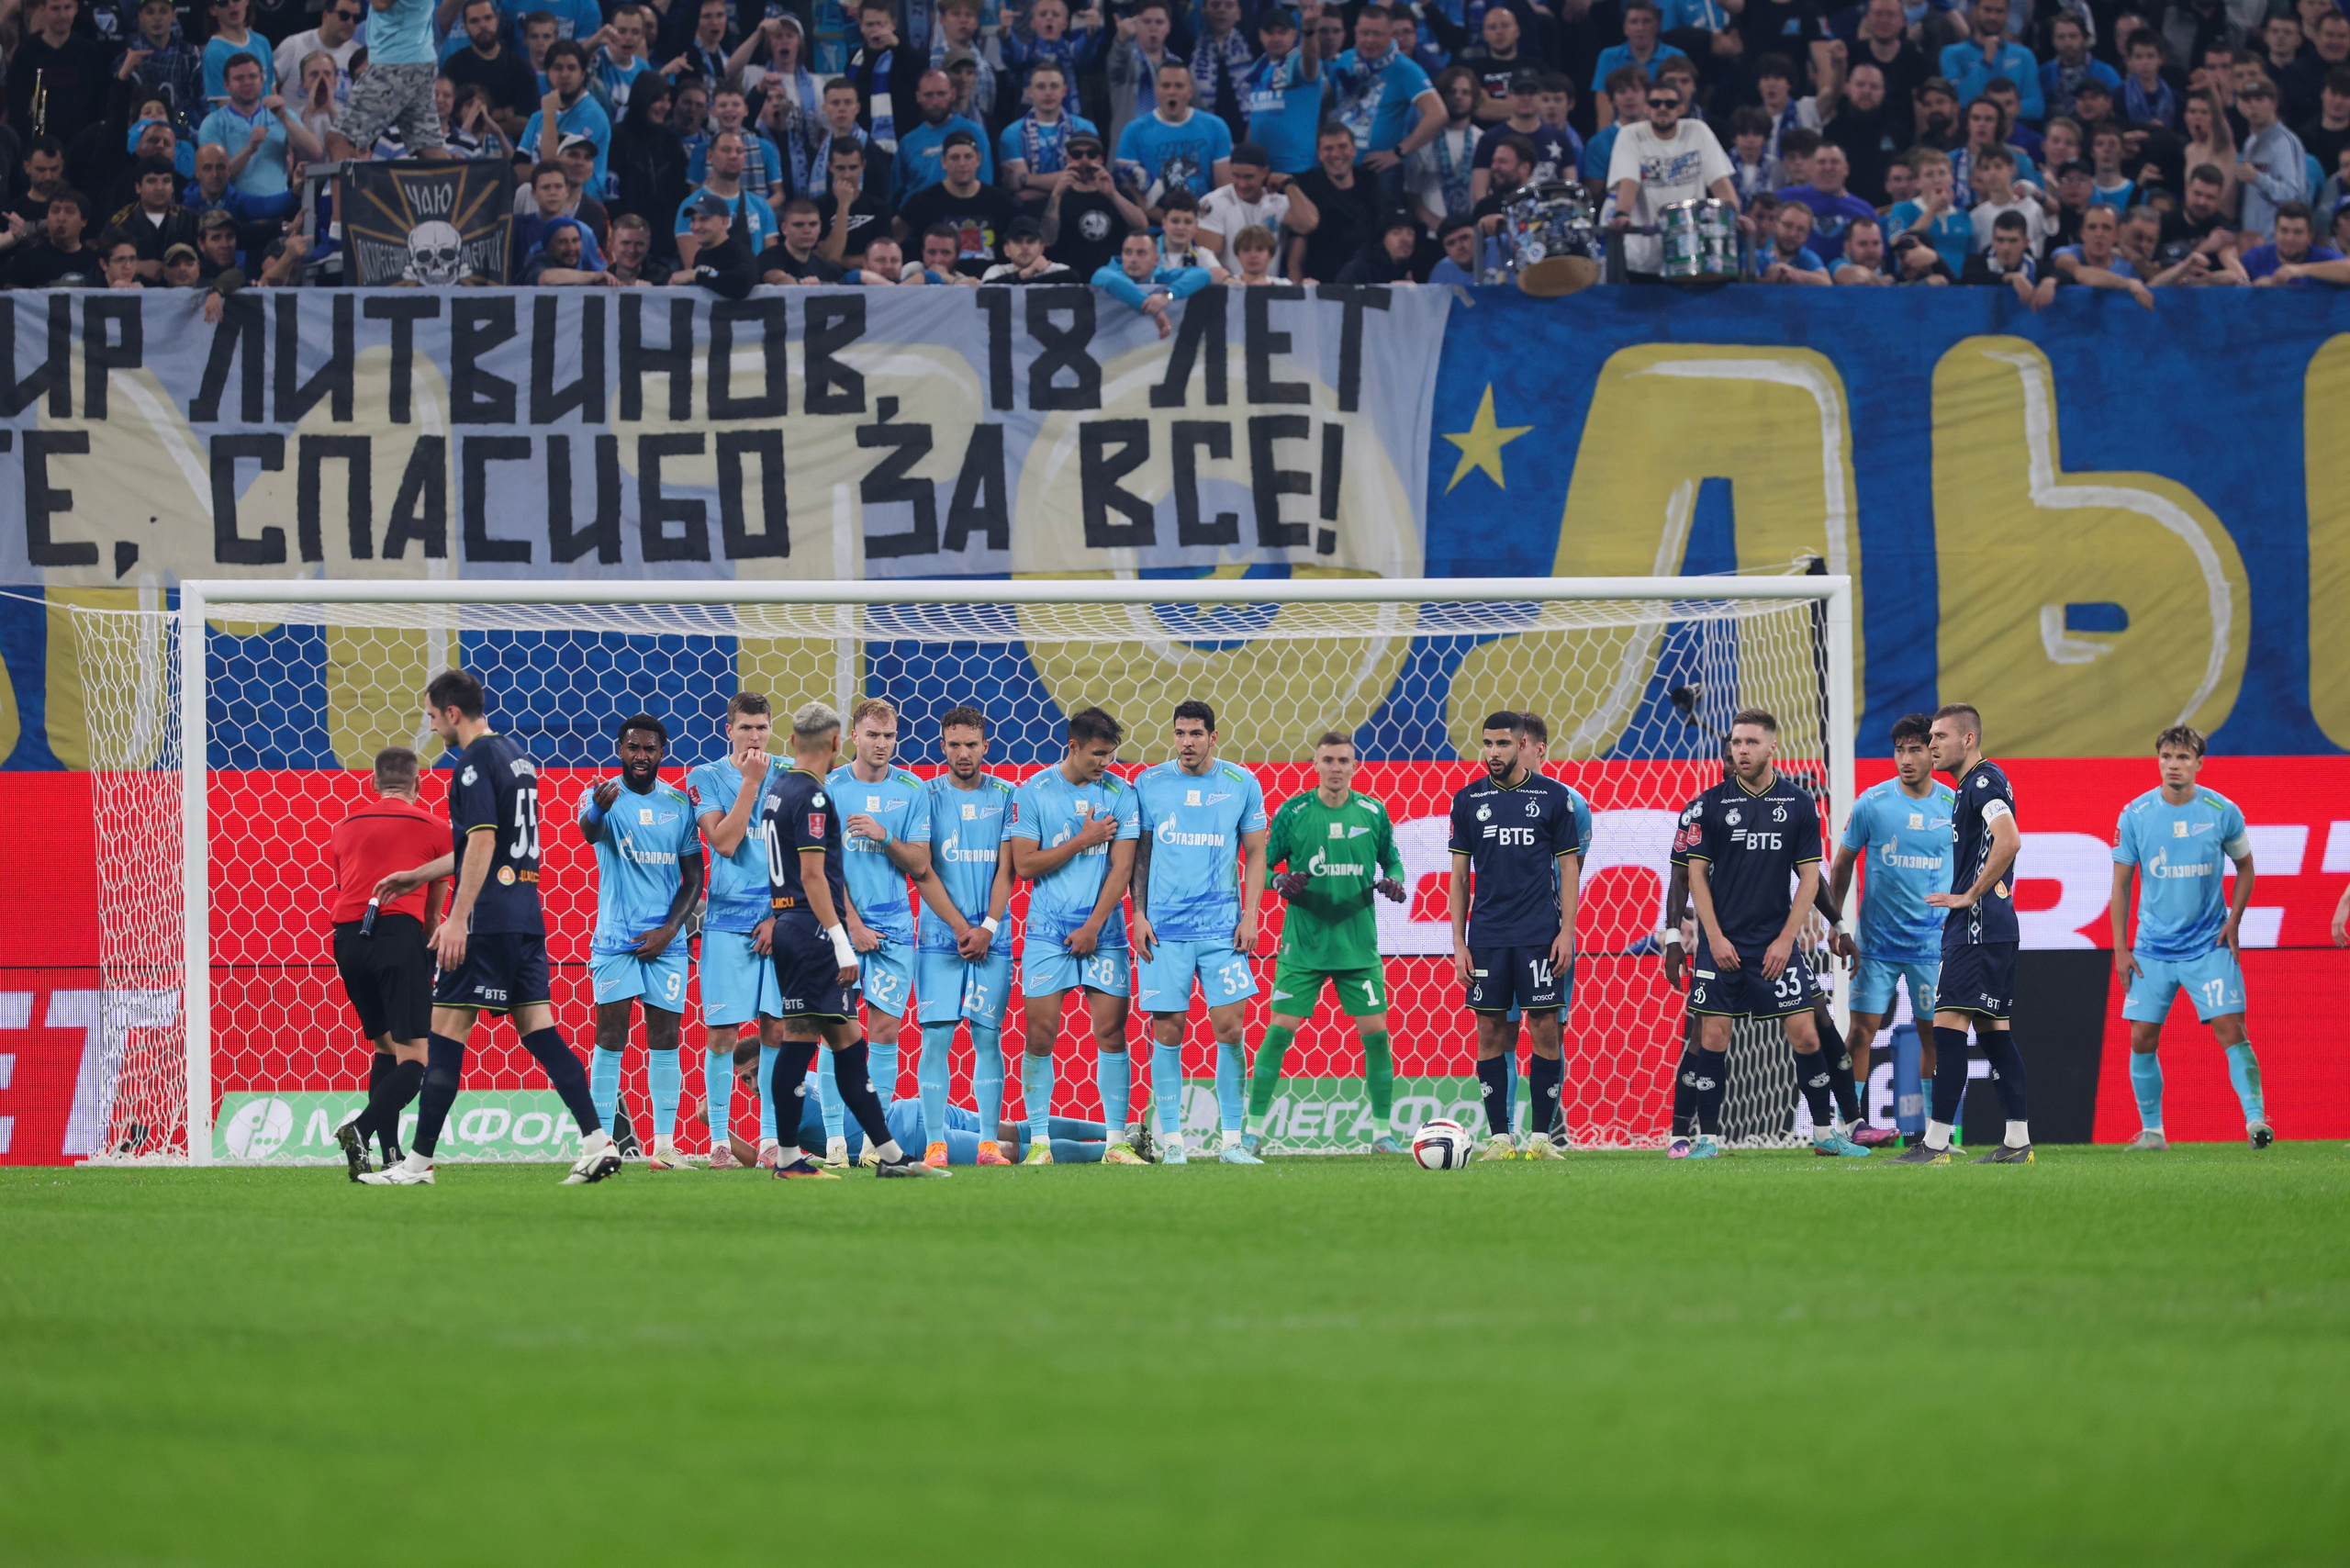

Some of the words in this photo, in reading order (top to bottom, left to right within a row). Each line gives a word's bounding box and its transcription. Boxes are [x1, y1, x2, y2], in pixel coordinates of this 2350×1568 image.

[404, 183, 453, 217] ЧАЮ
[189, 291, 900, 425] ЛИТВИНОВ,
[977, 286, 1102, 411] 18
[1149, 284, 1392, 412] ЛЕТ
[209, 428, 790, 566] СПАСИБО
[856, 421, 1011, 559] ЗА
[1080, 414, 1345, 555] ВСЕ!
[509, 788, 540, 859] 55
[858, 839, 886, 853] ГАЗП
[1176, 833, 1225, 846] ГАЗПРОМ
[1499, 827, 1535, 846] ВТБ
[1746, 833, 1783, 850] ВТБ
[633, 851, 677, 865] ГАЗПРОМ
[959, 849, 998, 862] ГАЗПРОМ
[1897, 855, 1942, 869] ГАЗПРОМ
[1327, 864, 1364, 876] ГАЗПРОМ
[2167, 863, 2213, 878] ГАЗПРОМ
[1087, 956, 1114, 986] 28
[1218, 960, 1249, 996] 33
[1528, 958, 1553, 989] 14
[666, 974, 681, 1001] 9
[870, 967, 898, 1002] 32
[1361, 979, 1380, 1007] 1
[1774, 967, 1802, 999] 33
[2202, 979, 2225, 1008] 17
[485, 989, 507, 1001] ВТБ
[785, 999, 804, 1010] ВТБ
[963, 980, 989, 1013] 25
[1532, 993, 1553, 1002] BOSCO
[1778, 999, 1800, 1008] BOSCO
[1919, 984, 1939, 1012] 6
[1986, 997, 2000, 1011] ВТ
